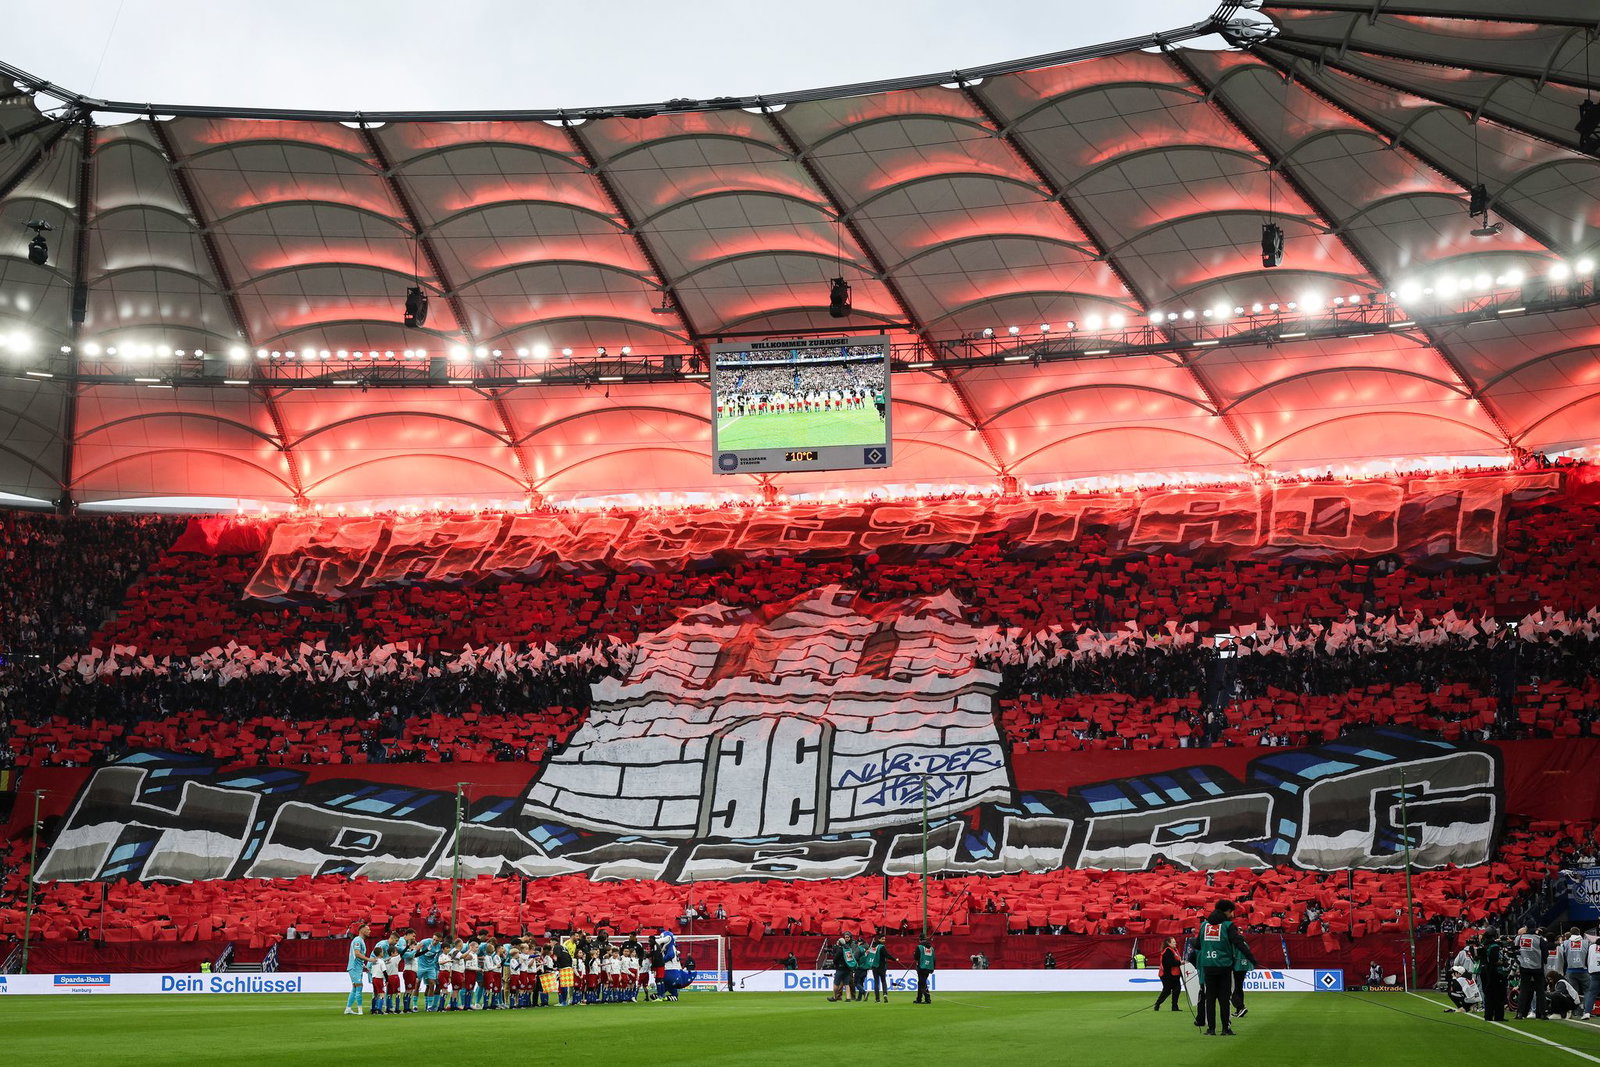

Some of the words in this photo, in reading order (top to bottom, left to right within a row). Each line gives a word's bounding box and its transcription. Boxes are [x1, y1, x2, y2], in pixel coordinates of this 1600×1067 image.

[751, 340, 807, 349] WILLKOMMEN
[808, 338, 849, 347] ZUHAUSE!
[33, 751, 1497, 883] HAMBURG
[1206, 950, 1217, 959] 16
[60, 976, 104, 984] Sparda-Bank
[161, 975, 204, 992] Dein
[210, 976, 302, 993] Schlüssel
[784, 972, 829, 990] Dein
